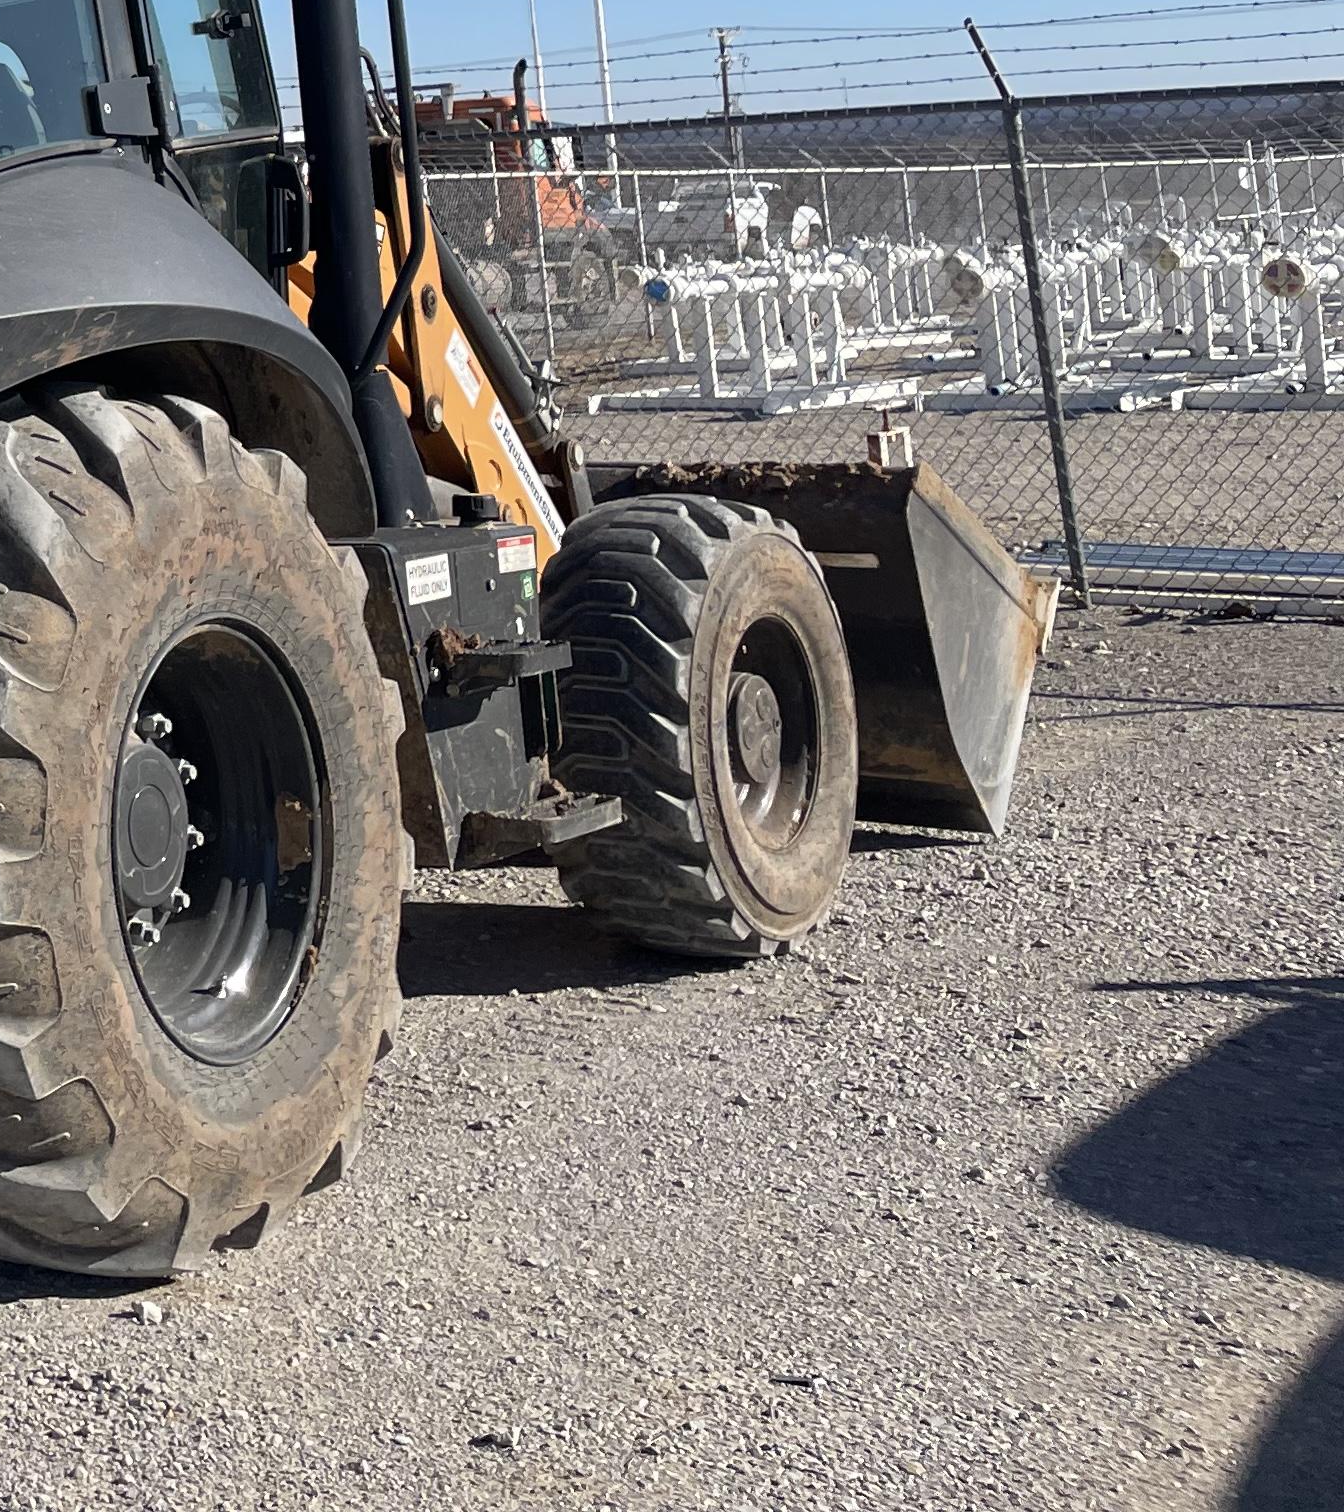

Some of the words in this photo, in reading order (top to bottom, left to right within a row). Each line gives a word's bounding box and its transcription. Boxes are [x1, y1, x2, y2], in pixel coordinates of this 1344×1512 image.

[408, 560, 448, 579] HYDRAULIC
[410, 582, 430, 598] FLUID
[431, 579, 449, 593] ONLY
